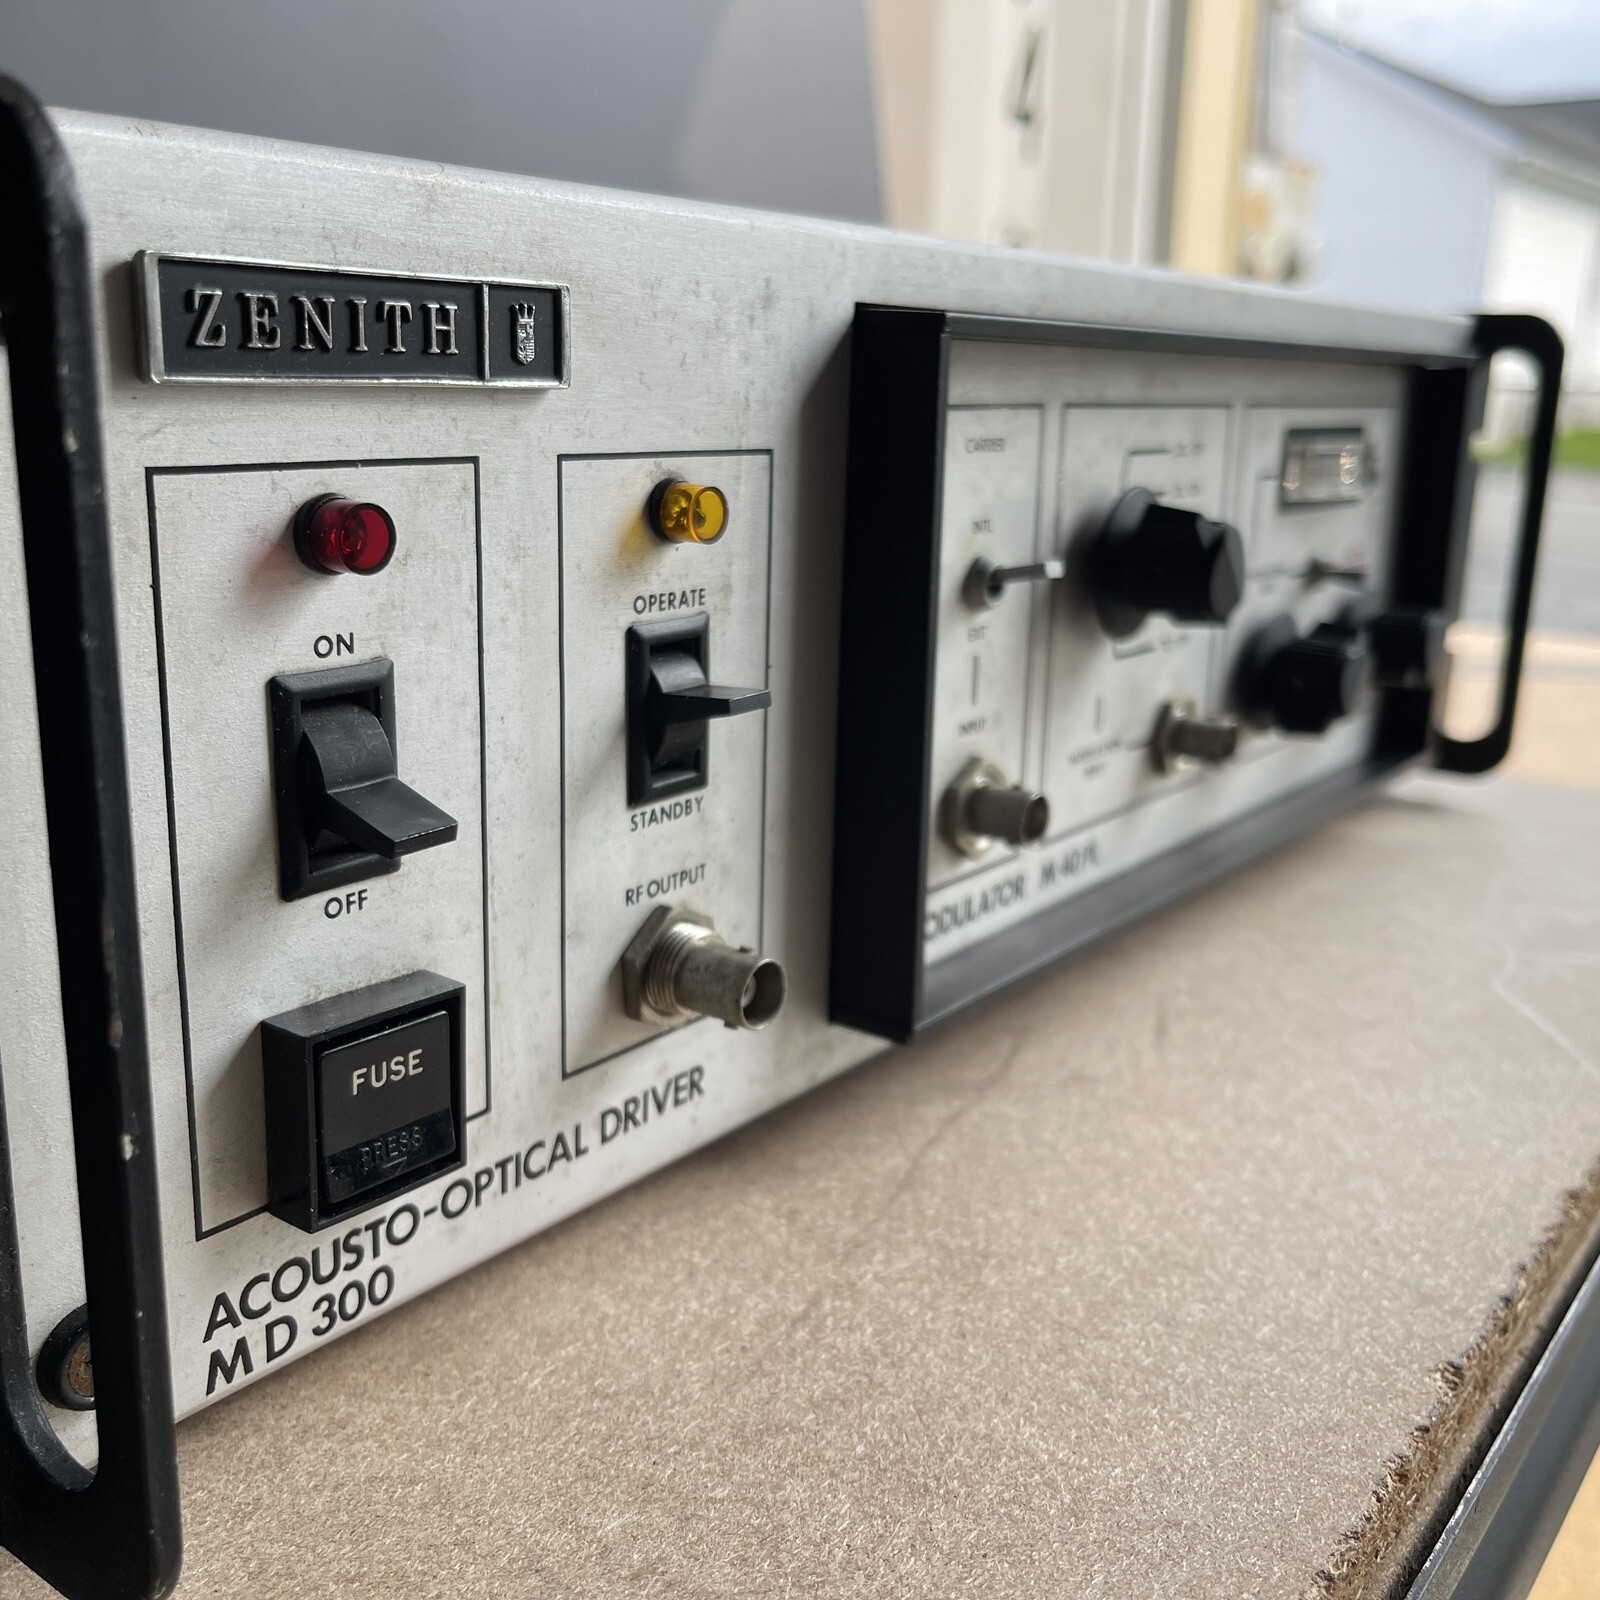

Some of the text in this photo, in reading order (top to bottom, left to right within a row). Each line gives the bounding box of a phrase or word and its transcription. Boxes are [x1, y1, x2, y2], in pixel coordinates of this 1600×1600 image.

[185, 287, 459, 355] ZENITH
[633, 588, 706, 614] OPERATE
[313, 632, 354, 658] ON
[630, 796, 704, 832] STANDBY
[324, 889, 368, 919] OFF
[625, 863, 706, 906] RF OUTPUT
[924, 873, 1024, 940] ODULATOR
[352, 1048, 423, 1096] FUSE
[361, 1126, 423, 1175] PRESS
[203, 1065, 706, 1344] ACOUSTO-OPTICAL DRIVER
[312, 1264, 395, 1337] 300
